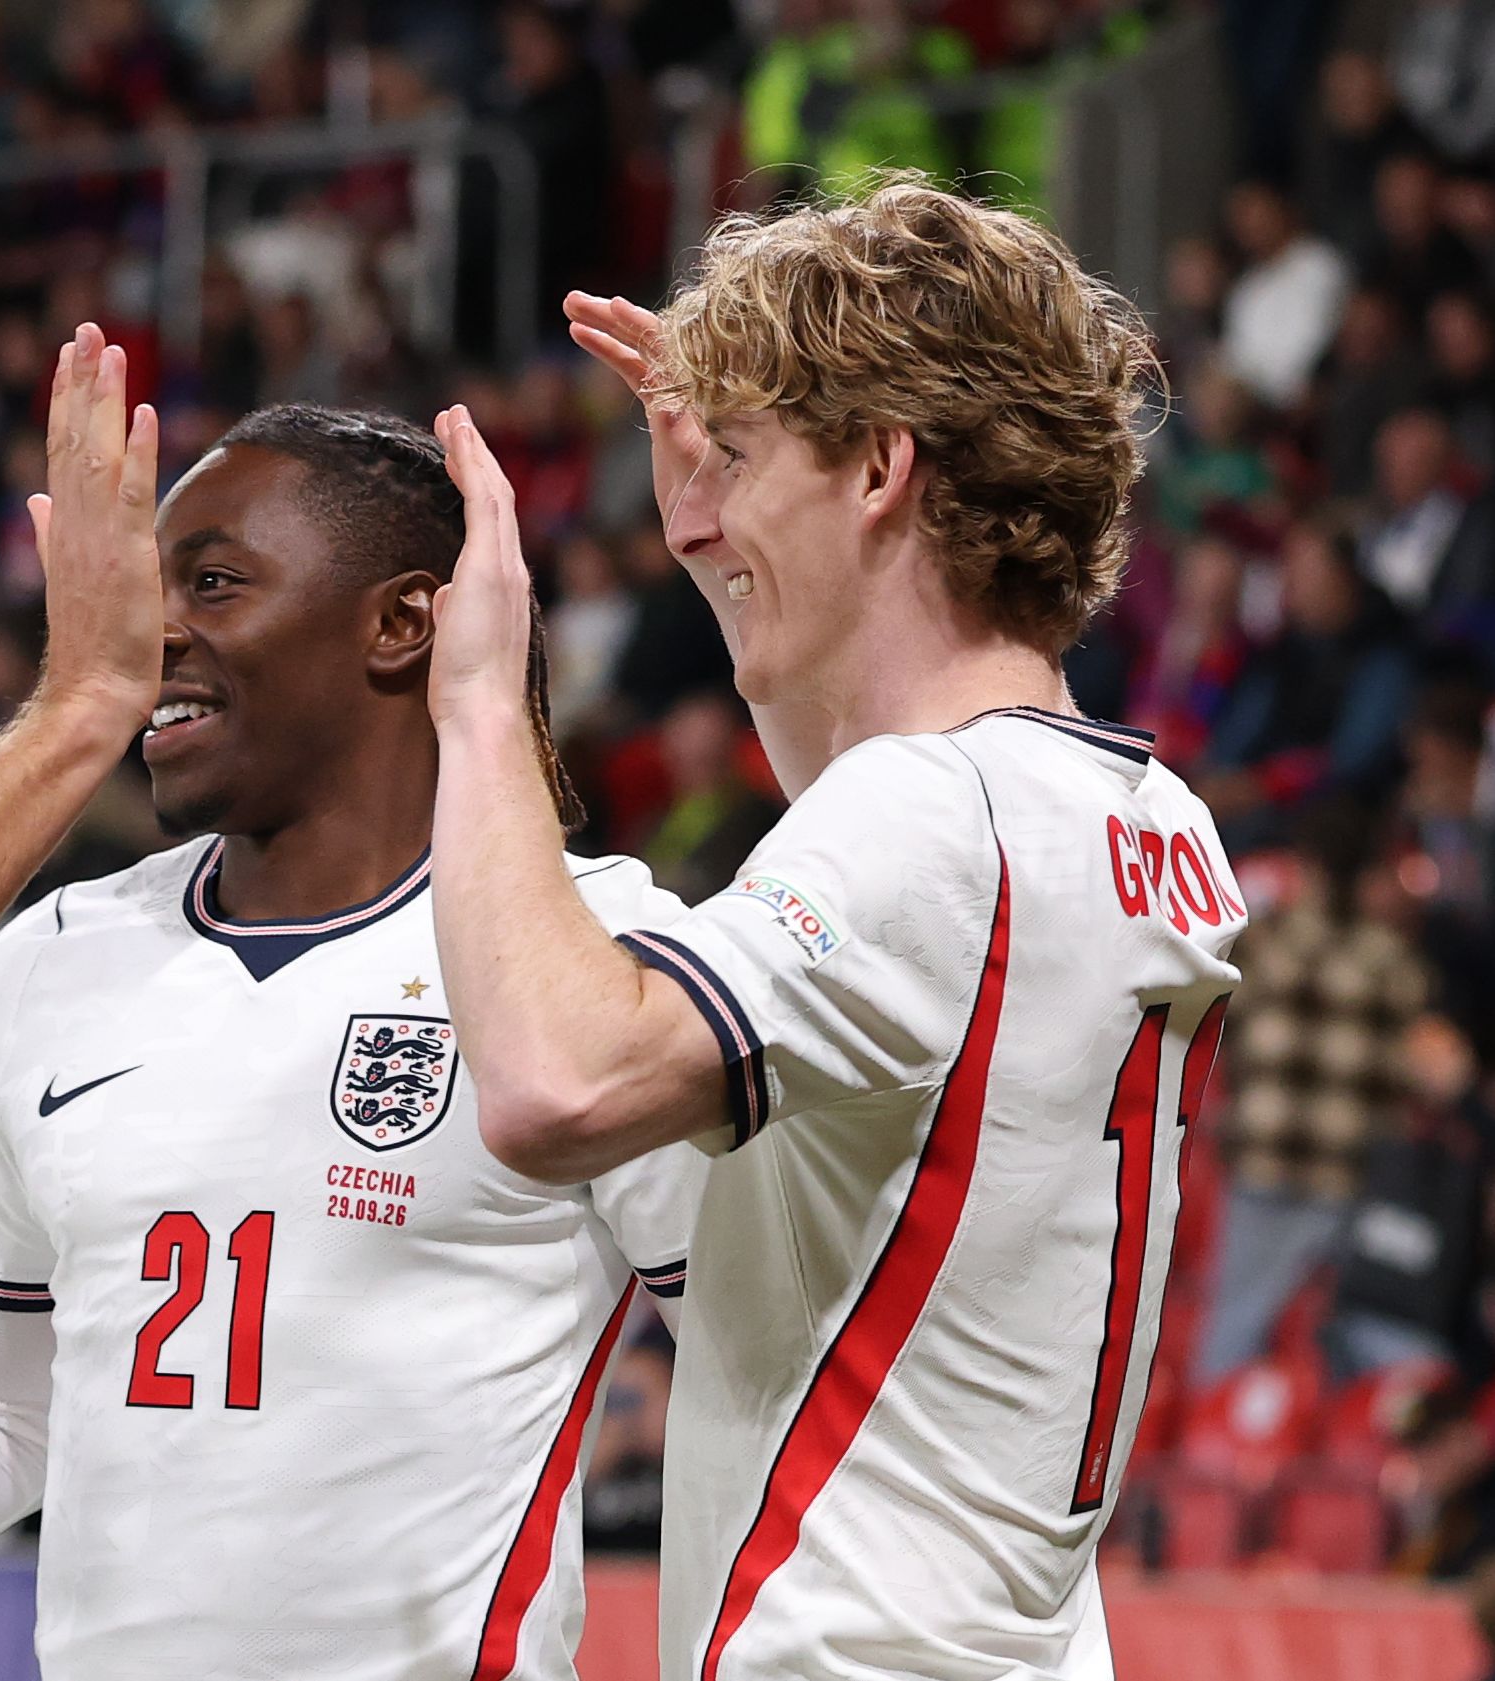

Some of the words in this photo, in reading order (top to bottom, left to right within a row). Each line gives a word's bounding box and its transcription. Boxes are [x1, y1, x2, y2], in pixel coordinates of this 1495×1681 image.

[740, 879, 835, 955] NDATION
[327, 1164, 415, 1199] CZECHIA
[327, 1194, 407, 1227] 29.09.26
[125, 1210, 275, 1410] 21
